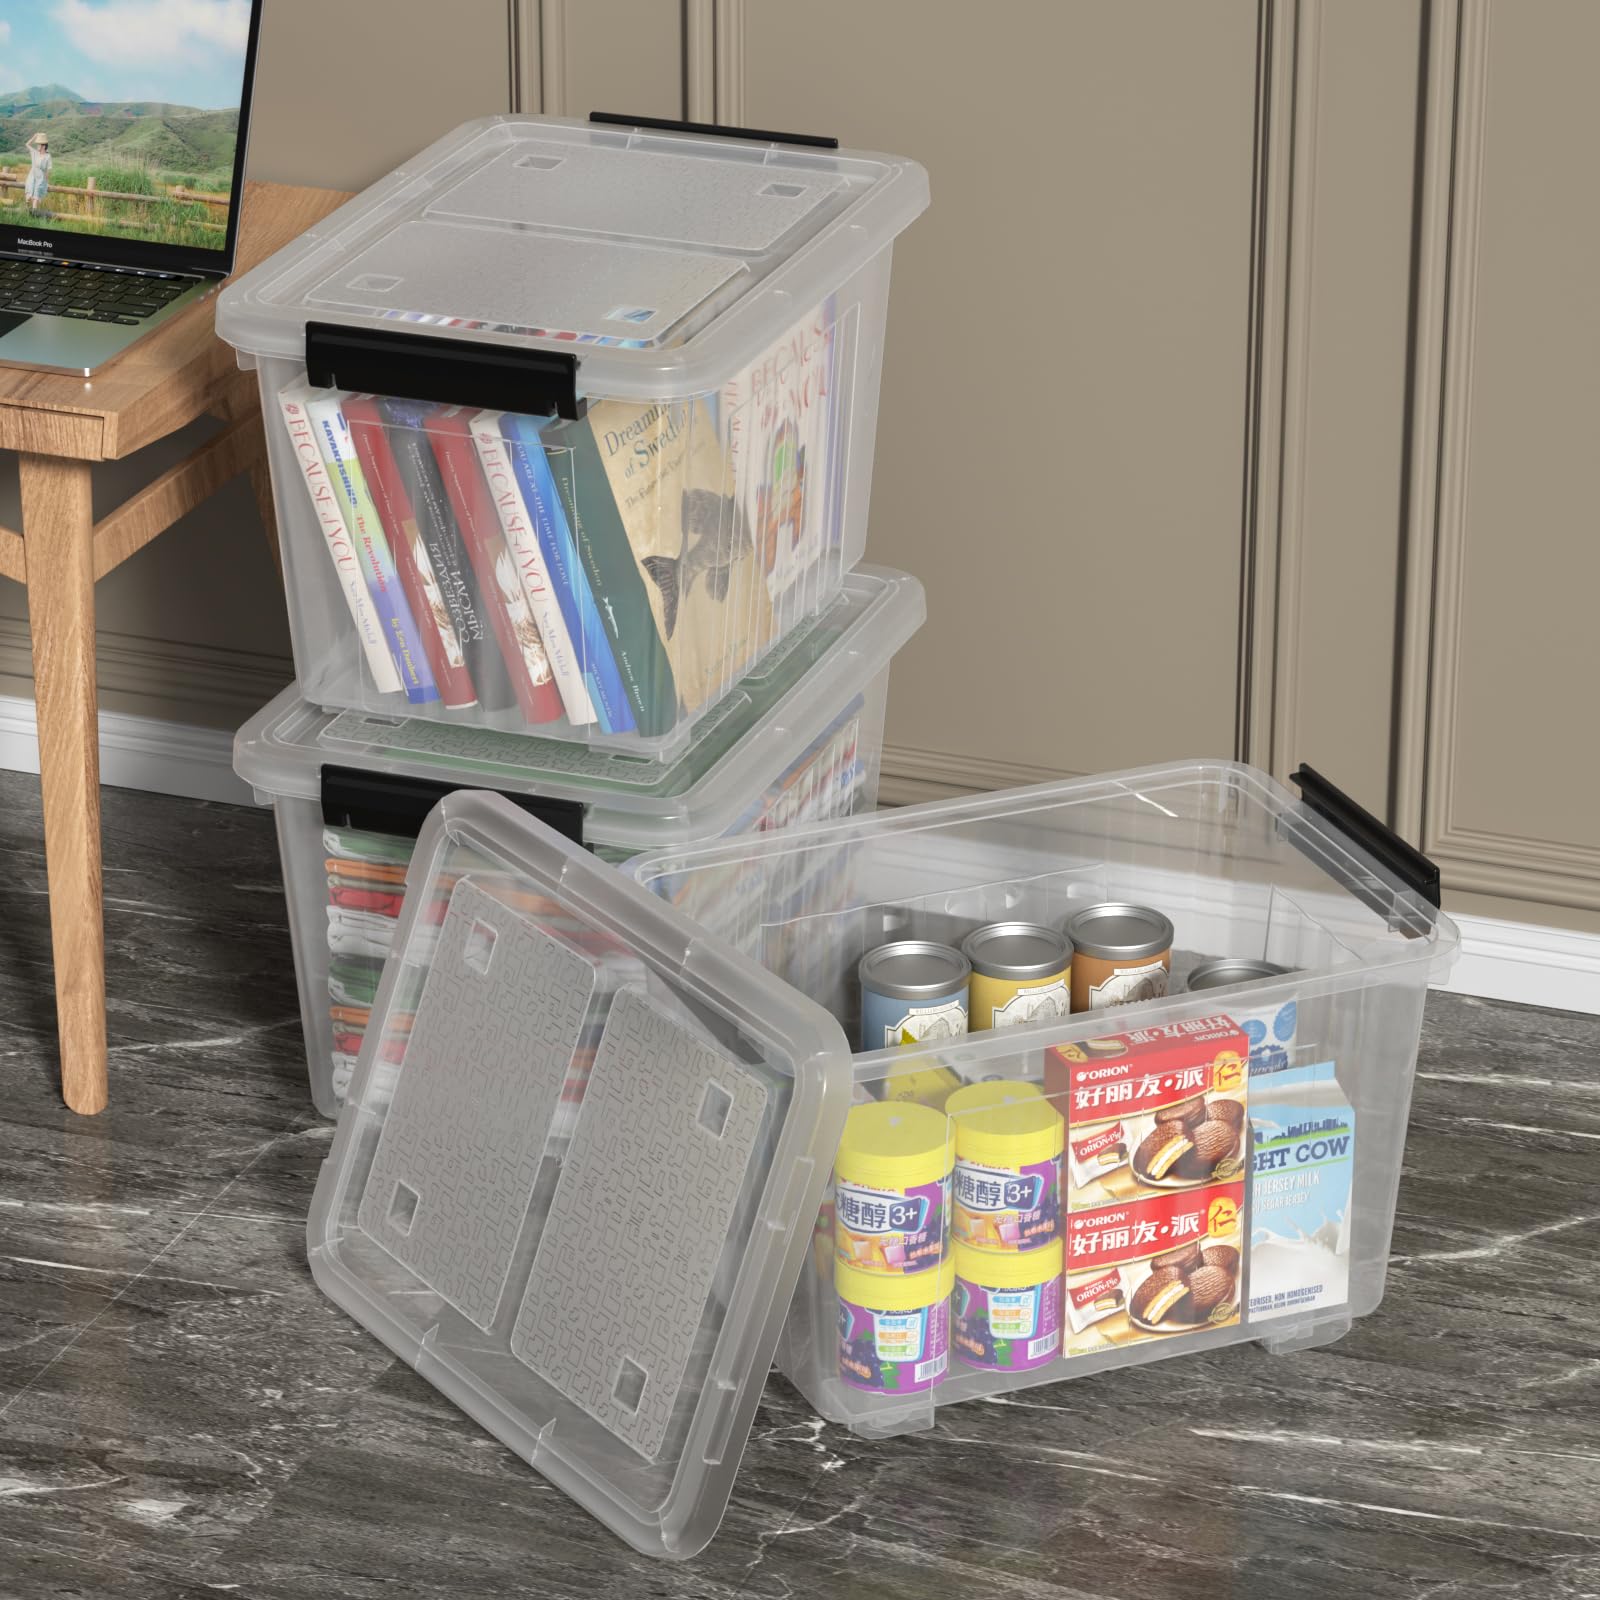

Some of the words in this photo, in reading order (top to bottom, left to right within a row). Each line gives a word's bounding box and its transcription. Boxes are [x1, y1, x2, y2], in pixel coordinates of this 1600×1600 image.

[17, 238, 42, 247] MacBook
[289, 419, 333, 506] BECAUSE
[328, 526, 357, 572] YOU
[482, 449, 527, 535] BECAUSE
[521, 558, 547, 602] YOU
[356, 512, 367, 534] The
[365, 536, 387, 593] Revolution
[429, 543, 471, 644] СОЗВЕЗДИЯ
[450, 571, 483, 641] МЫСЛИ
[621, 650, 634, 682] Andrew
[632, 685, 645, 712] Brown
[1087, 1065, 1130, 1080] ORION
[1214, 1061, 1242, 1087] 仁
[1295, 1136, 1350, 1163] COW
[1297, 1168, 1320, 1188] MILK
[1008, 1185, 1033, 1203] 3+
[891, 1206, 918, 1225] 3+
[1084, 1212, 1126, 1227] ORION
[1210, 1205, 1237, 1233] 仁
